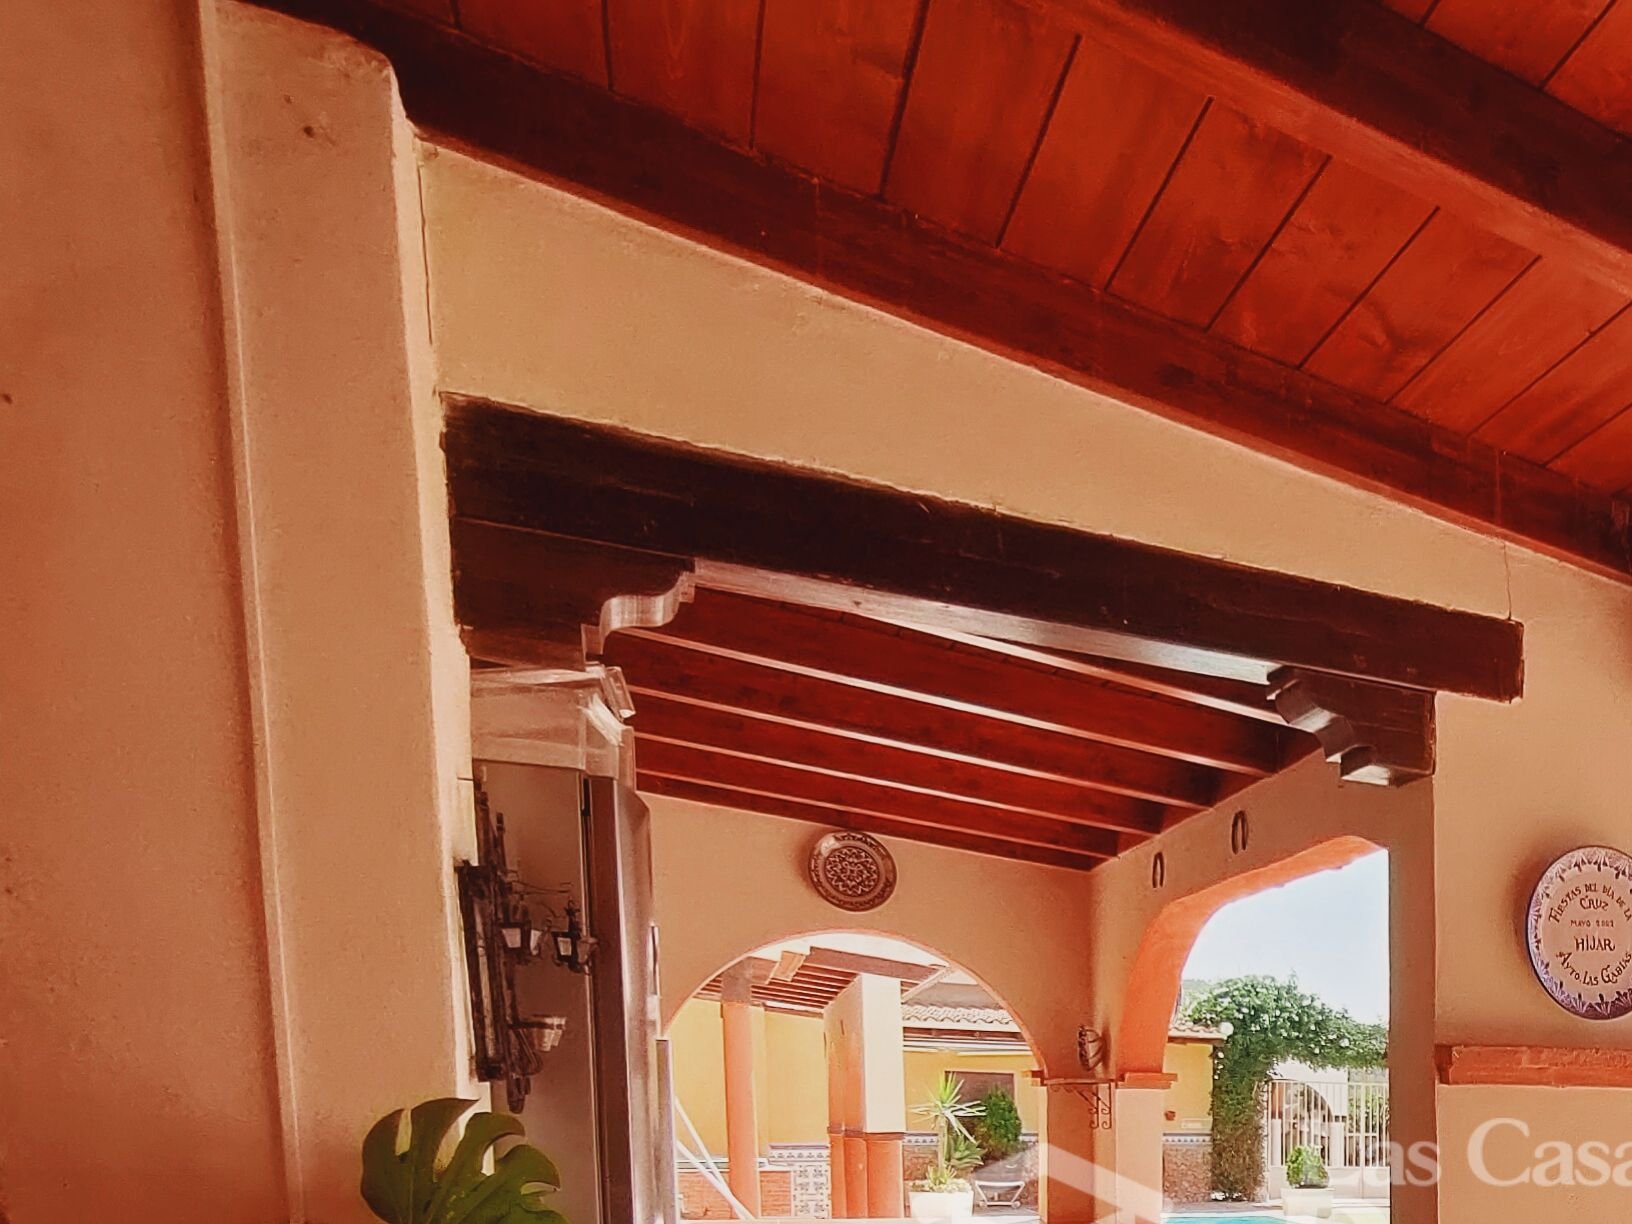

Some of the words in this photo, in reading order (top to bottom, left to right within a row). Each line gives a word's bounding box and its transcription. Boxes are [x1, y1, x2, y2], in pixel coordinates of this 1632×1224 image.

[1579, 895, 1609, 911] CRUZ
[1570, 919, 1591, 927] MAYO
[1583, 971, 1599, 985] LAS
